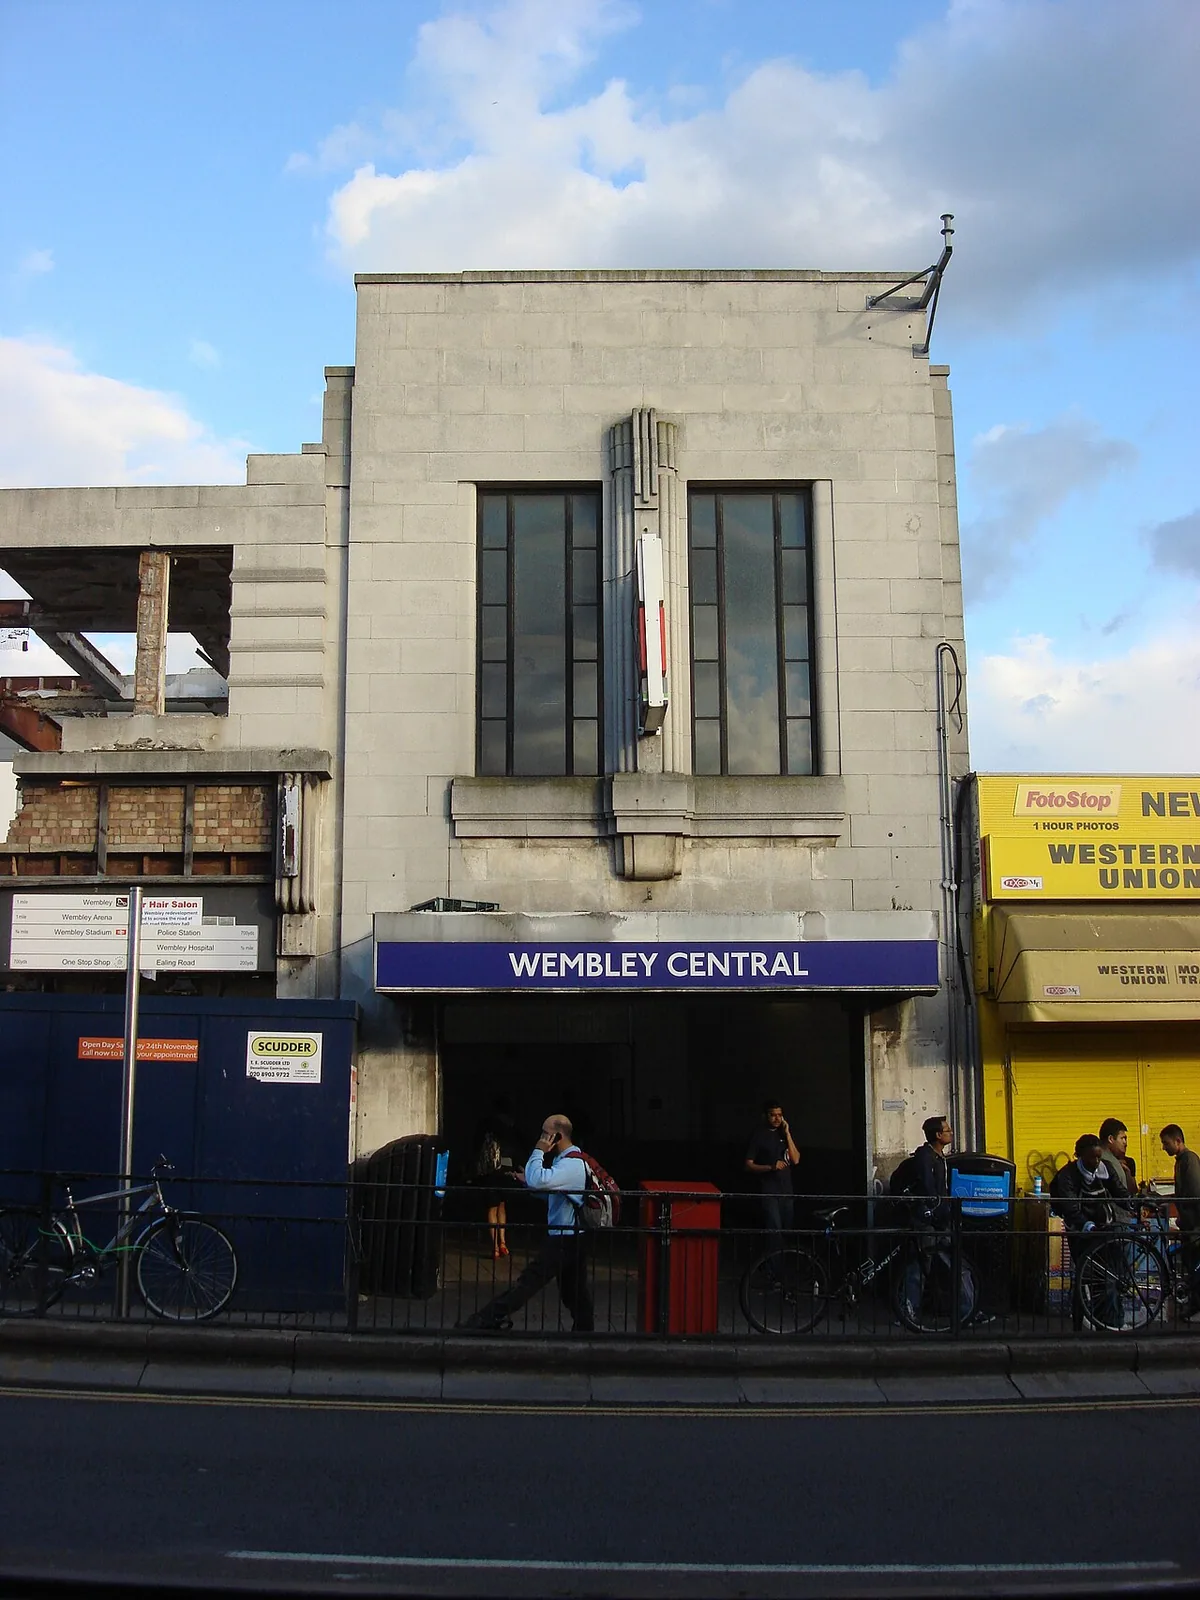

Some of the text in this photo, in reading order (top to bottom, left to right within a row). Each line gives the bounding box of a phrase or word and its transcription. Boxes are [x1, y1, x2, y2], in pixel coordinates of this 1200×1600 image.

[1026, 791, 1111, 812] FotoStop
[1141, 791, 1200, 817] NE
[1033, 822, 1120, 831] 1 HOUR PHOTOS
[1048, 844, 1200, 865] WESTERN
[1099, 868, 1200, 889] UNION
[82, 899, 113, 907] Wembley
[61, 914, 92, 922] Wembley
[53, 929, 85, 937] Wembley
[157, 944, 187, 952] Wembley
[188, 944, 215, 952] Hospital
[77, 959, 93, 967] Stop
[93, 959, 111, 967] Shop
[156, 959, 176, 967] Ealing
[508, 950, 810, 977] WEMBLEY CENTRAL
[1097, 965, 1165, 975] WESTERN
[1178, 965, 1199, 975] MO
[1120, 975, 1166, 985] UNION
[1178, 975, 1200, 985] TR
[82, 1041, 100, 1049] Open
[101, 1042, 116, 1050] Day
[116, 1042, 145, 1051] Saay
[258, 1041, 311, 1052] SCUDDER
[137, 1052, 152, 1060] your
